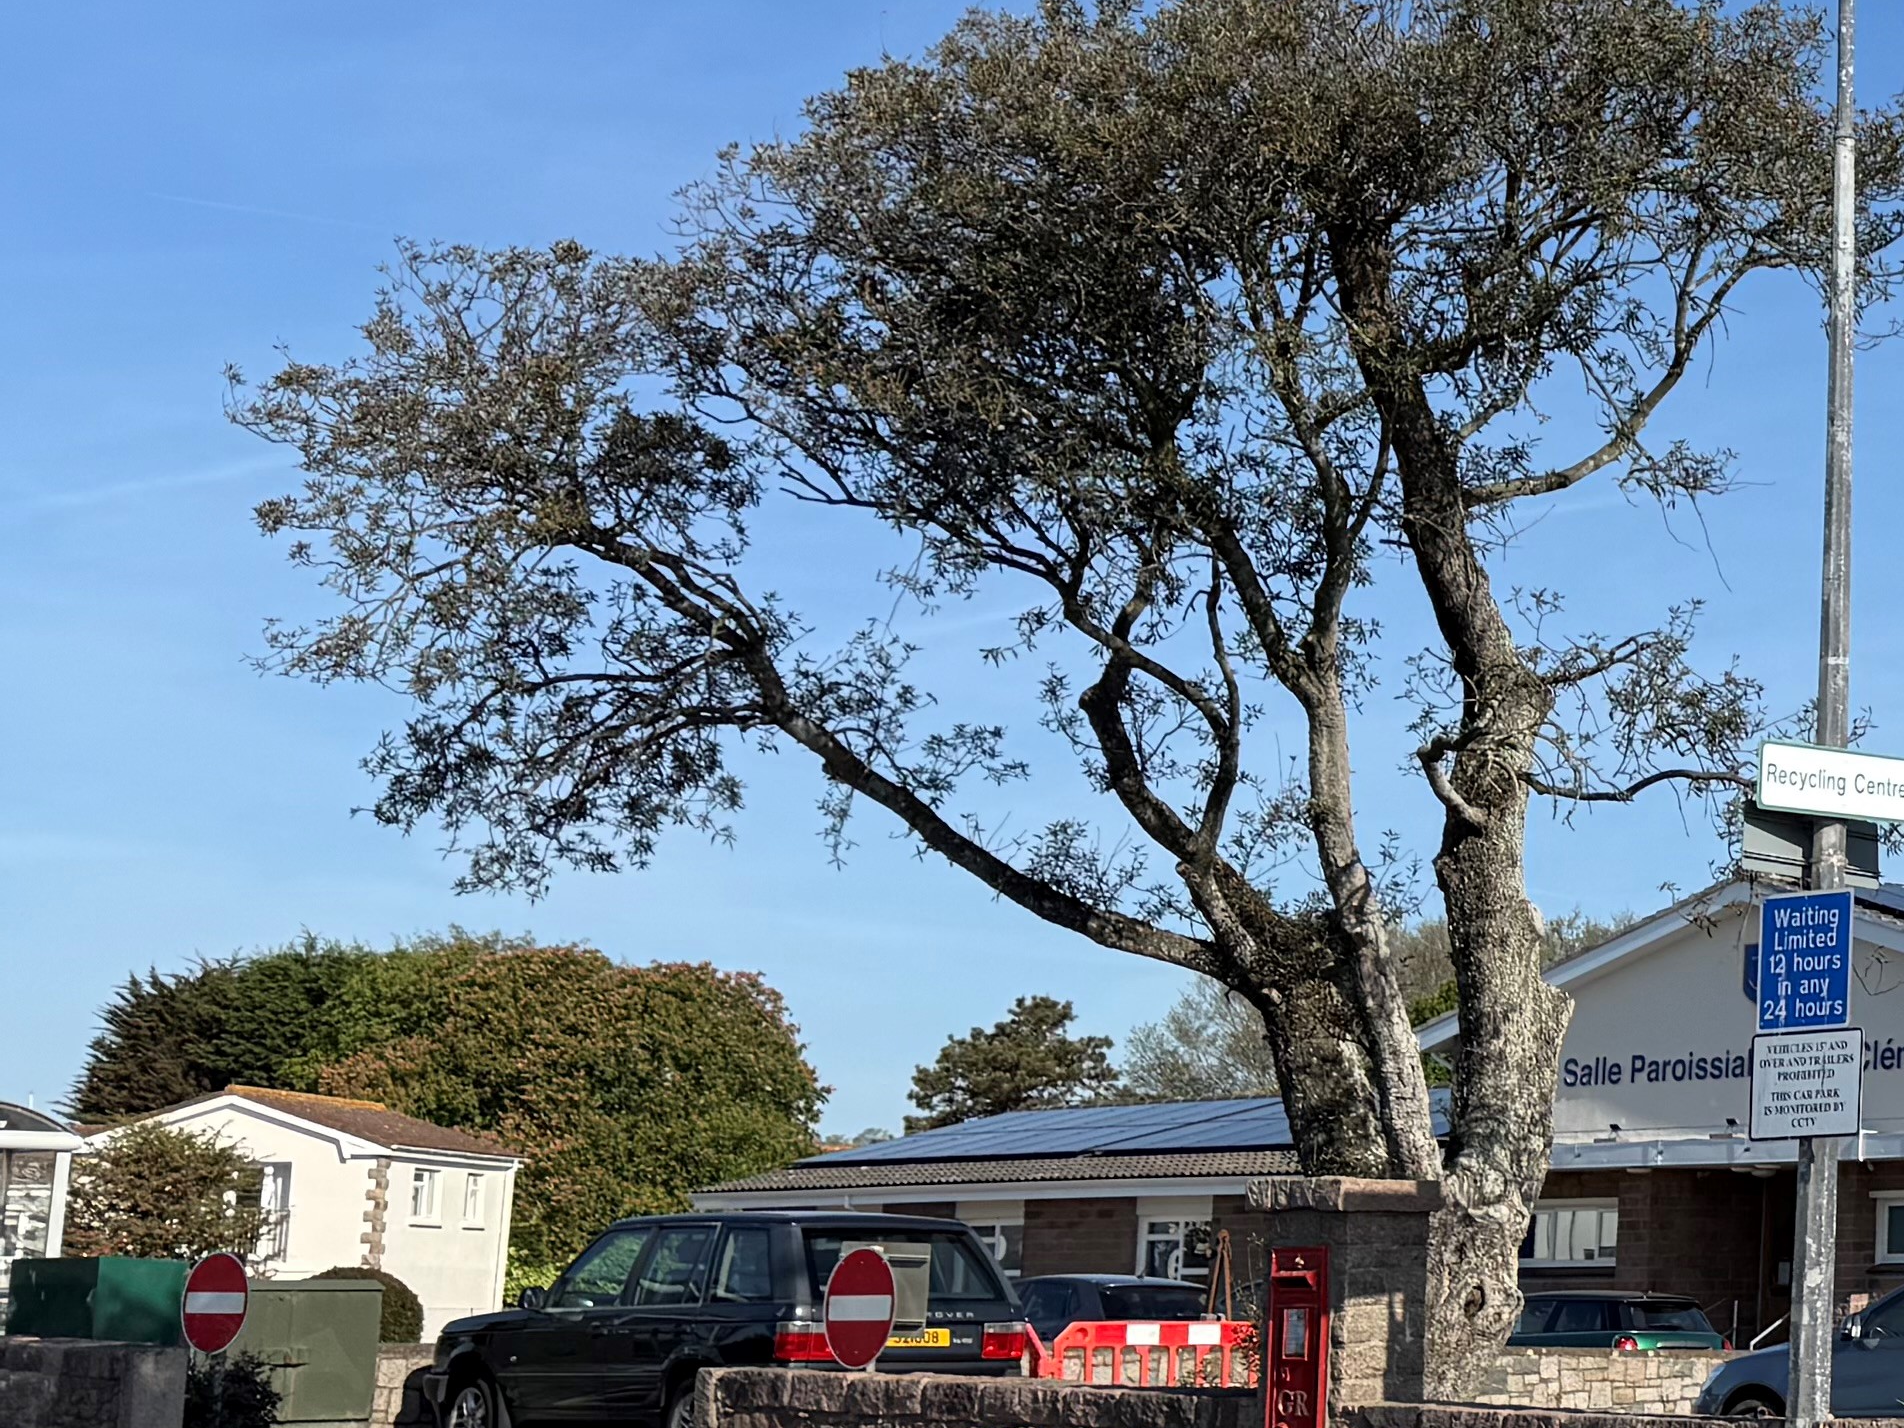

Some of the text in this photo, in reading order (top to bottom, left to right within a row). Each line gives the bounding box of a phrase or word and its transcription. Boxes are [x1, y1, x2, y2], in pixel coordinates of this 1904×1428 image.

[1767, 763, 1846, 796] Recycling
[1774, 906, 1839, 928] Waiting
[1774, 928, 1836, 951] Limited
[1769, 952, 1841, 974] 12 hours
[1777, 977, 1829, 997] in any
[1763, 998, 1843, 1020] 24 hours
[1767, 1042, 1813, 1054] VEHICLES
[1828, 1040, 1848, 1051] AND
[1564, 1056, 1622, 1087] Salle
[1760, 1054, 1854, 1069] OVER AND TRAILERS
[1777, 1069, 1835, 1082] PROHIBITED
[1771, 1088, 1840, 1102] THIS CAR PARK
[1764, 1101, 1845, 1116] IS MONITORED BY
[1791, 1117, 1816, 1128] CCTV
[1278, 1389, 1309, 1417] GR
